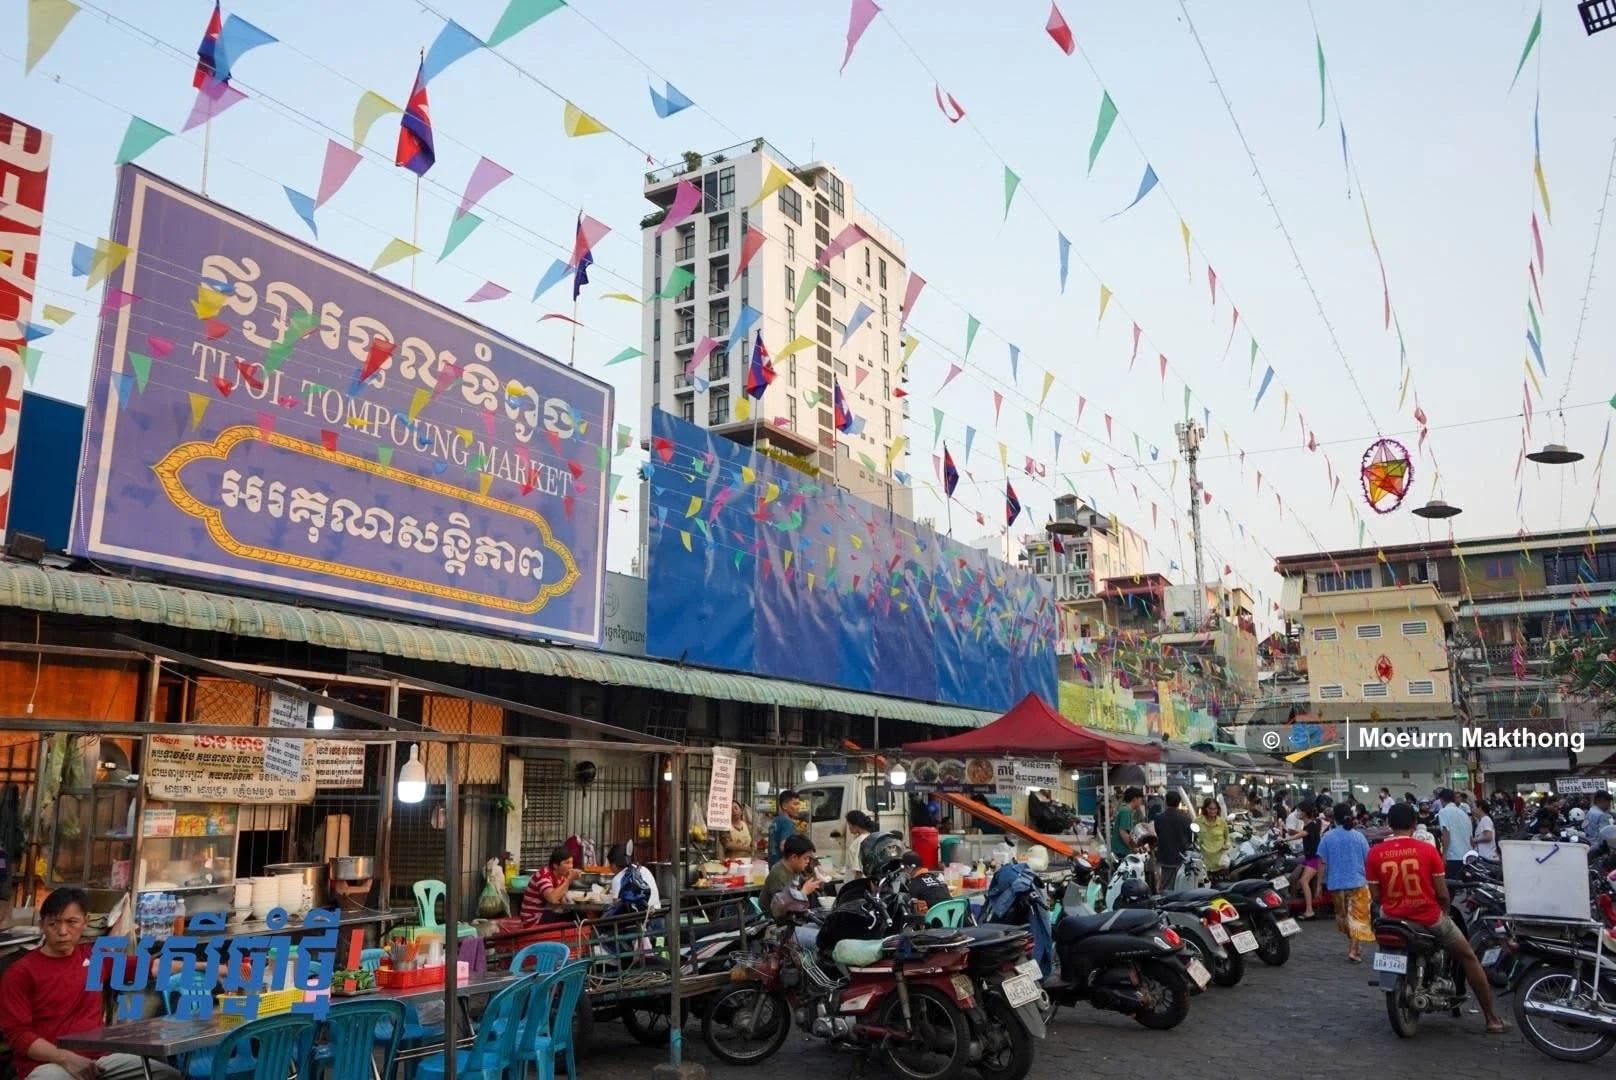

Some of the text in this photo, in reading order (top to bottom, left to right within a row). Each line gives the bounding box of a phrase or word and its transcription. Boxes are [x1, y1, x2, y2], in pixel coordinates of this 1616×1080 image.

[301, 378, 470, 467] TOMPOUNG
[477, 440, 573, 498] MARKET
[1381, 858, 1421, 897] 26
